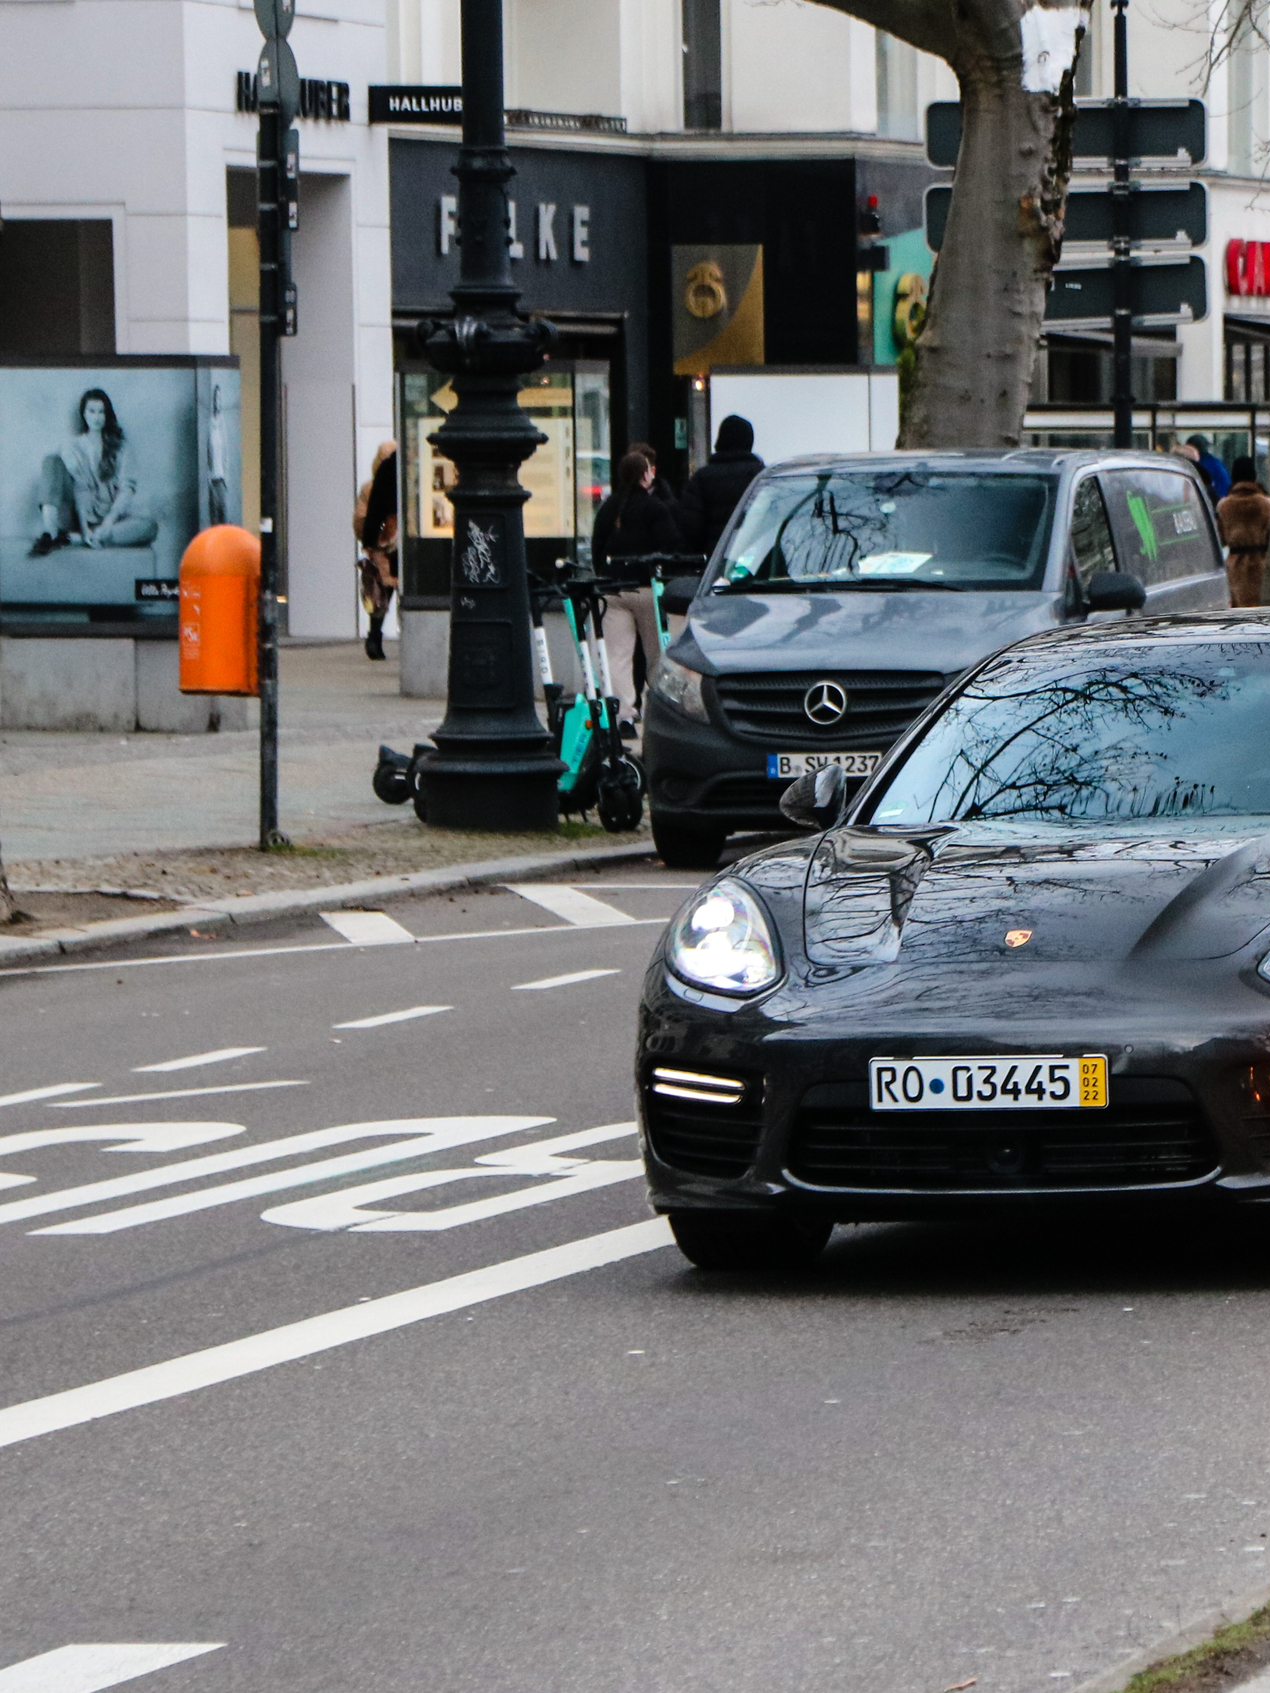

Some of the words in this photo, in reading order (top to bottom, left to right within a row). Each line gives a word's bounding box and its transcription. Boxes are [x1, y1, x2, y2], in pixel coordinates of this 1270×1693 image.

[441, 195, 590, 262] FLKE
[780, 756, 791, 774] B
[1082, 1064, 1098, 1074] 07
[876, 1066, 924, 1103] RO
[952, 1064, 1071, 1102] 03445
[1082, 1077, 1099, 1087] 02
[1083, 1090, 1099, 1101] 22
